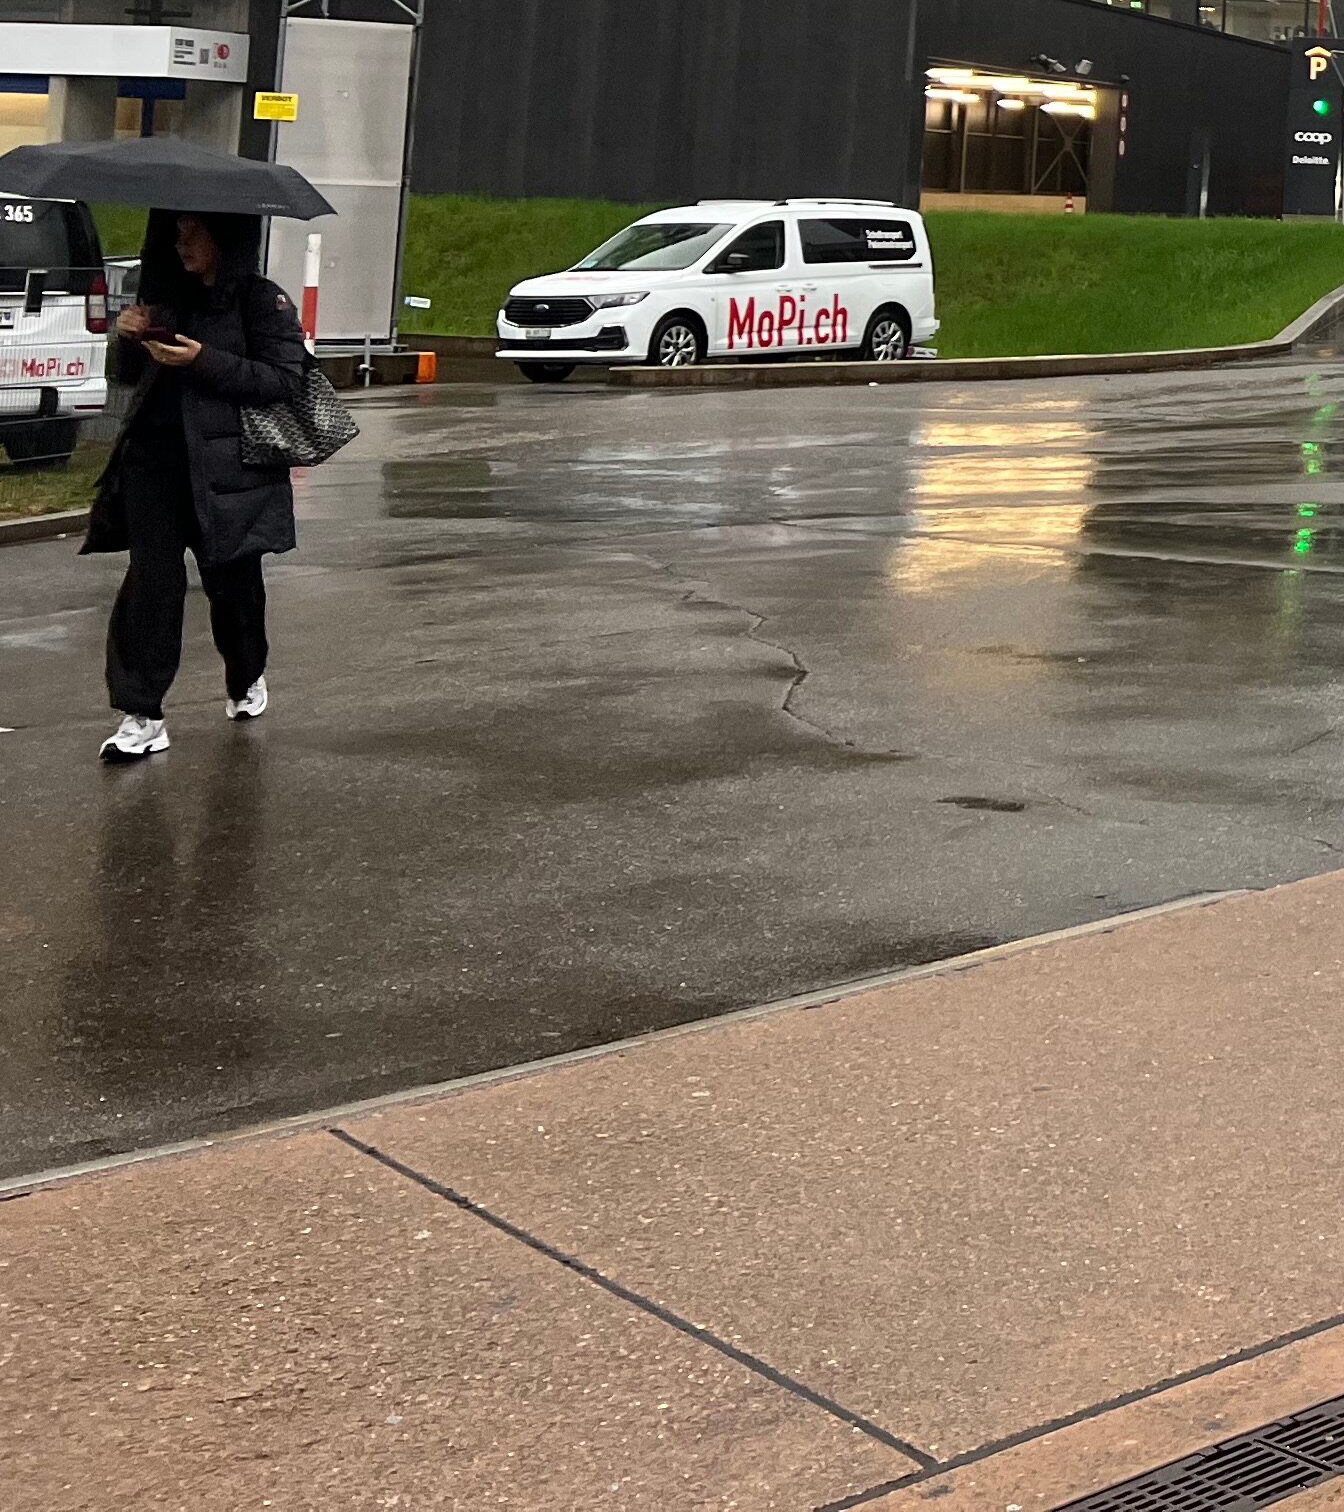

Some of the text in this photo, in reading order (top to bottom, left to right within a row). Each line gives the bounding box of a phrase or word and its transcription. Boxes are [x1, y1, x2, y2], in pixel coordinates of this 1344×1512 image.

[1309, 56, 1327, 80] P
[1294, 131, 1332, 145] coop
[4, 205, 33, 223] 365
[727, 293, 848, 349] MoPi.ch
